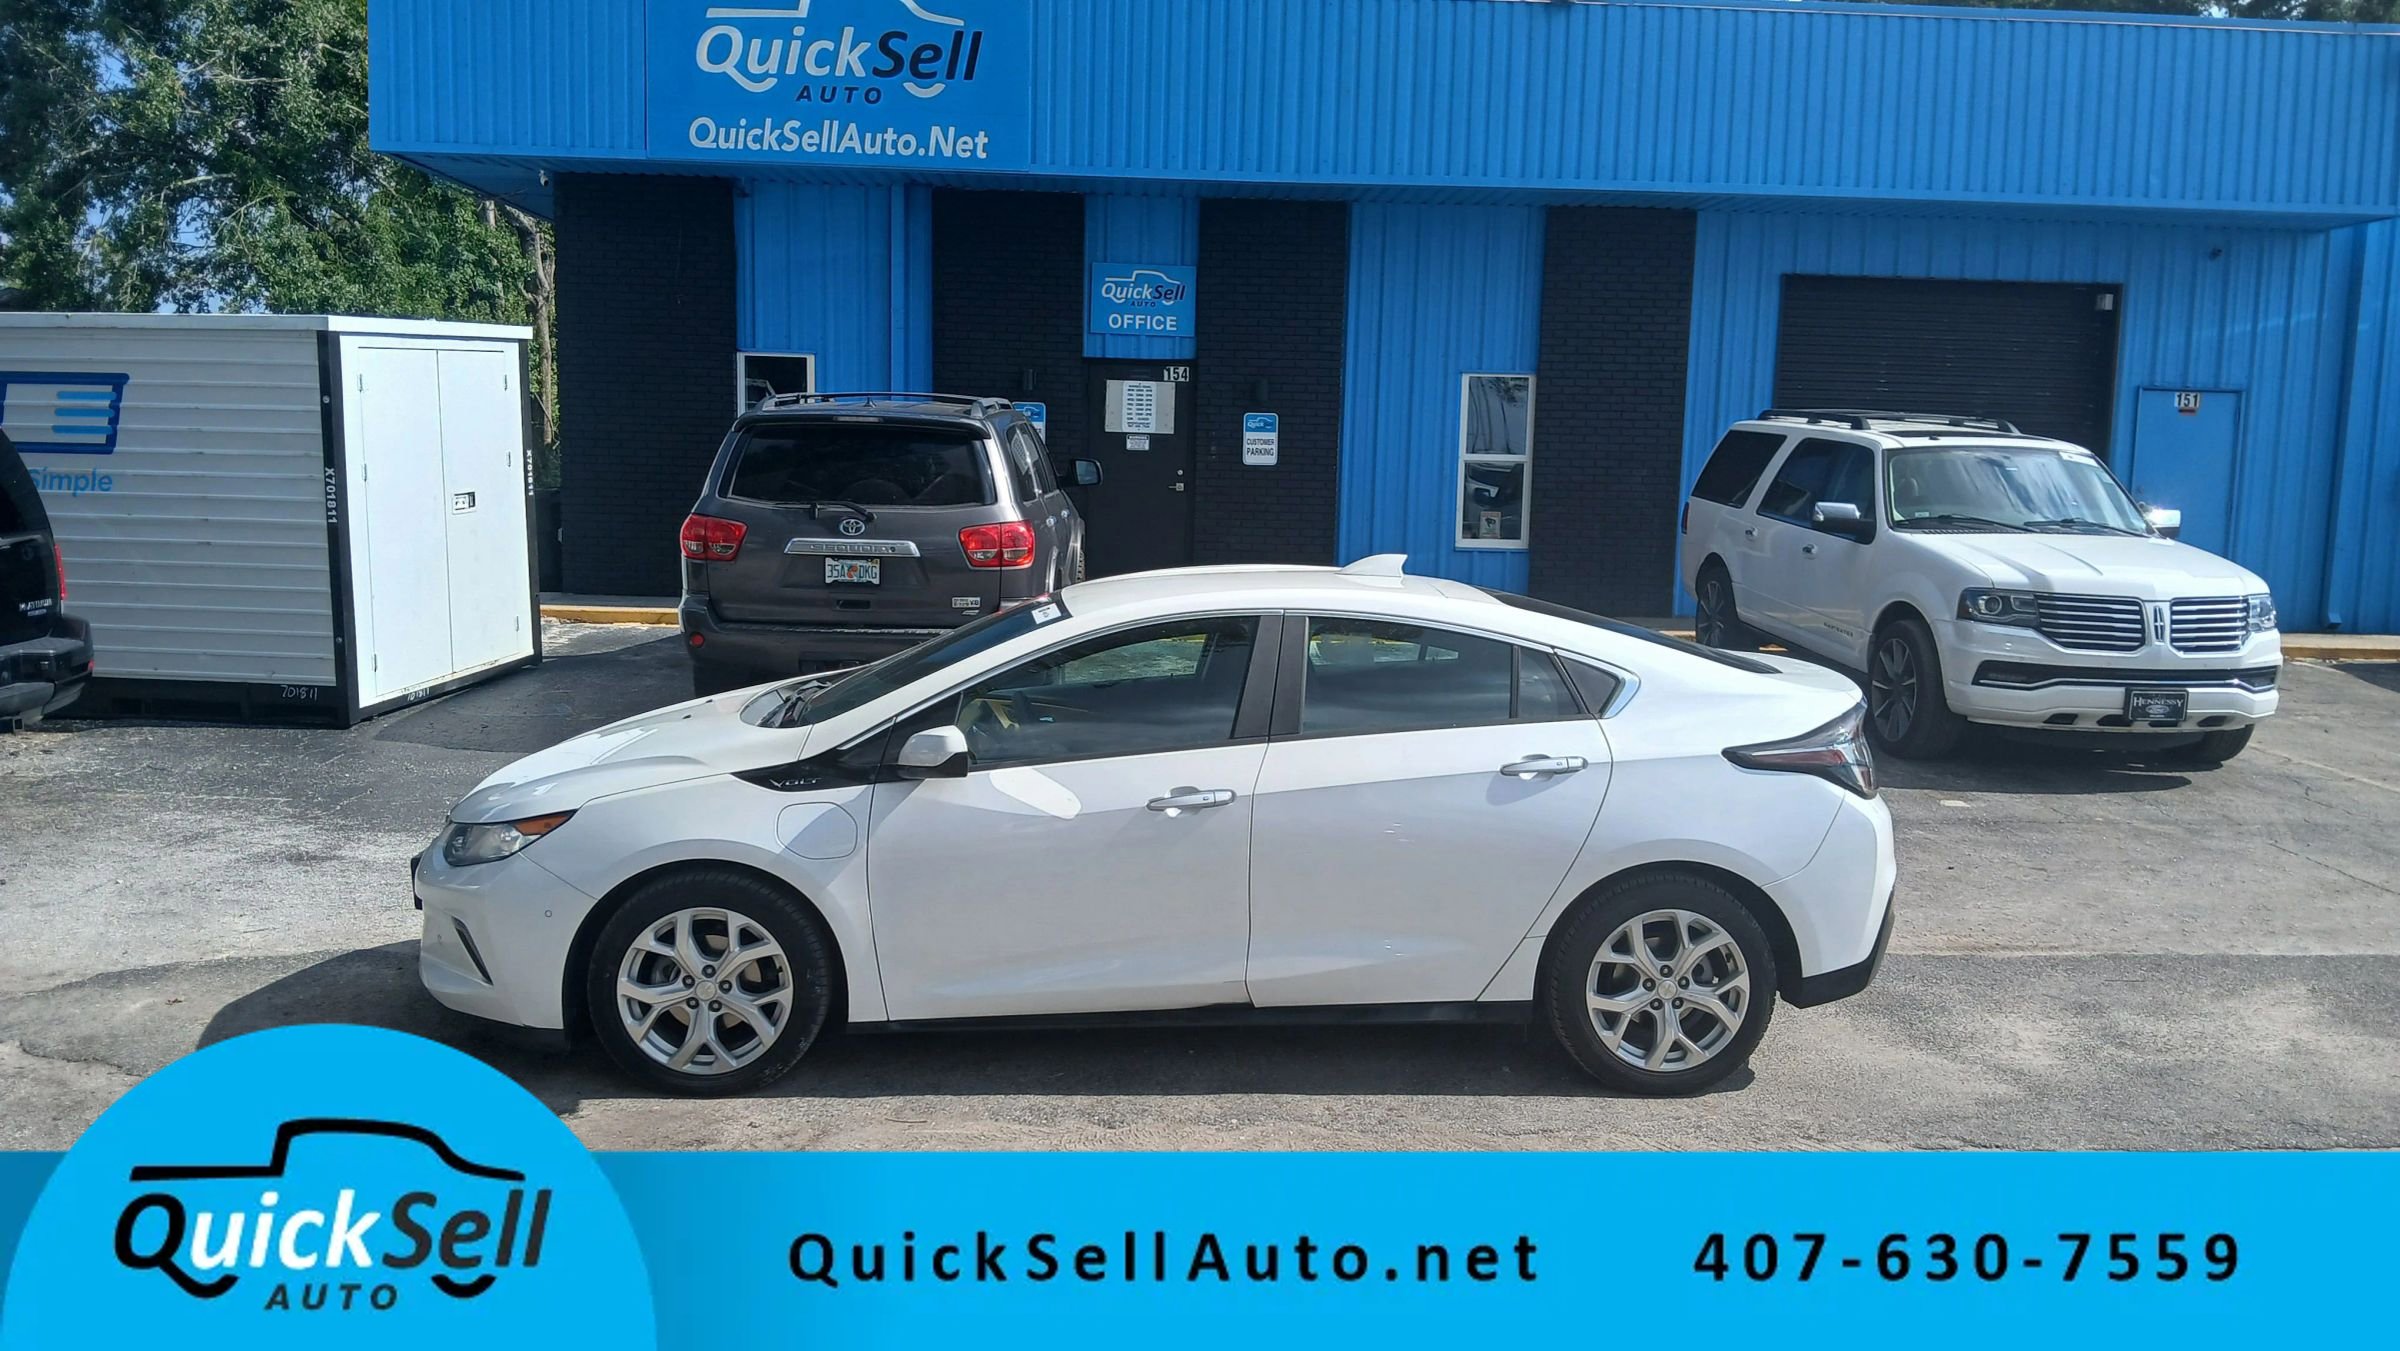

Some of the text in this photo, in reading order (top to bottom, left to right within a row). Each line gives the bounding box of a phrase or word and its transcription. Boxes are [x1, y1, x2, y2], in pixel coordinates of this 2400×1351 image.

[696, 25, 983, 93] QuickSell
[796, 85, 883, 105] AUTO
[689, 117, 989, 159] QuickSellAuto.Net
[1101, 282, 1186, 304] QuickSell
[1130, 300, 1157, 308] AUTO
[1108, 313, 1178, 331] OFFICE
[1165, 367, 1188, 381] 154
[2176, 392, 2199, 408] 151
[1246, 438, 1275, 446] CUSTOMER
[1246, 447, 1275, 457] PARKING
[325, 467, 338, 523] X701811
[858, 564, 878, 580] DKG
[280, 684, 318, 701] 701811
[2133, 696, 2184, 708] HENNESSY
[769, 777, 823, 788] VOLT
